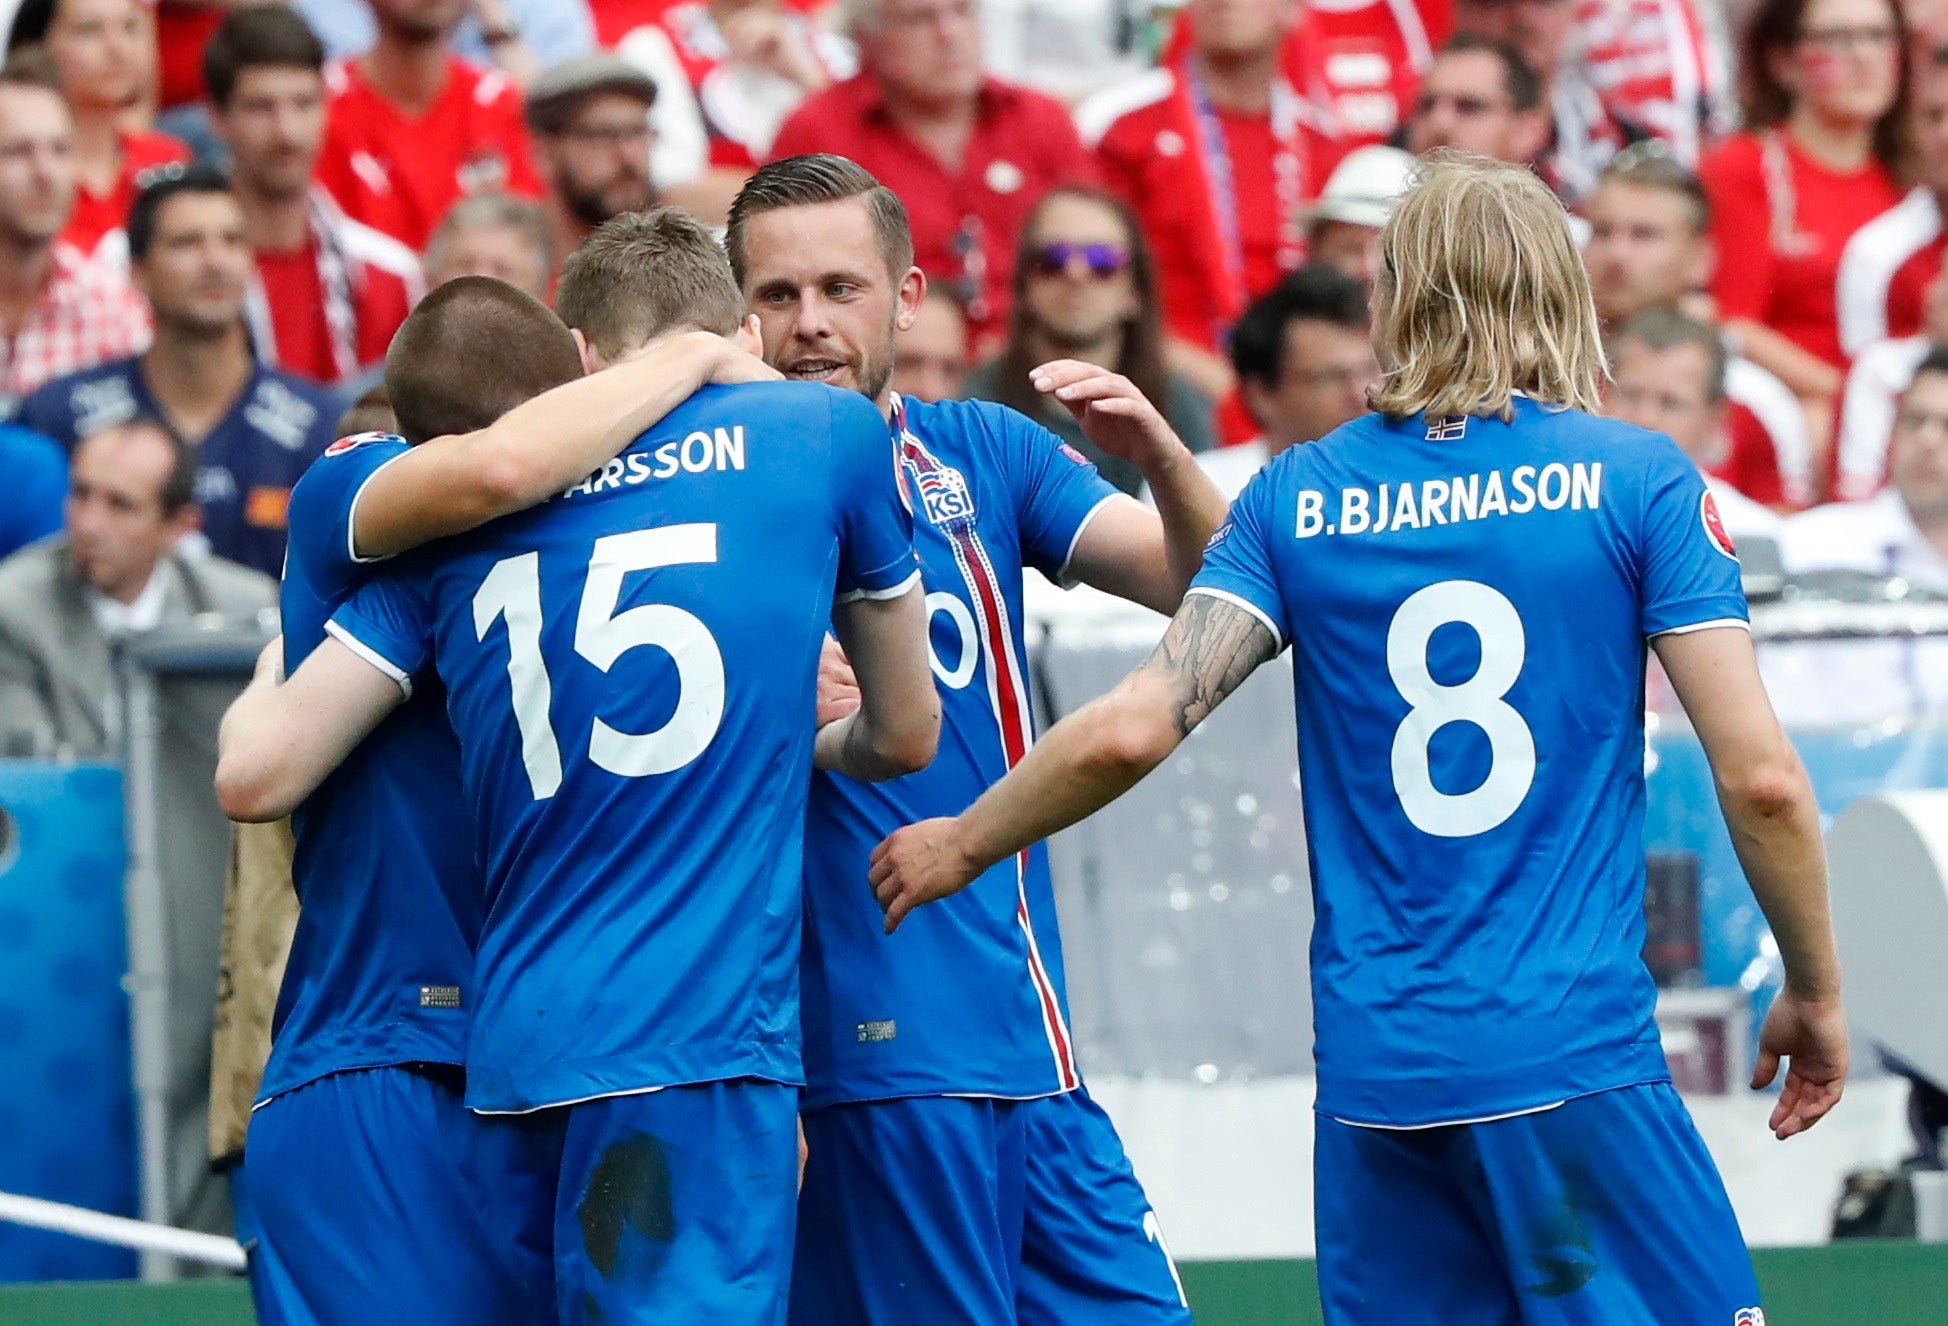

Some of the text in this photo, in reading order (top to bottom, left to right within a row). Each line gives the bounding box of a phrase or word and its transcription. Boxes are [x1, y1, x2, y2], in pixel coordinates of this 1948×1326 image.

[543, 425, 745, 503] ARSSON
[1295, 462, 1602, 538] B.BJARNASON
[472, 522, 726, 801] 15
[1386, 579, 1537, 837] 8
